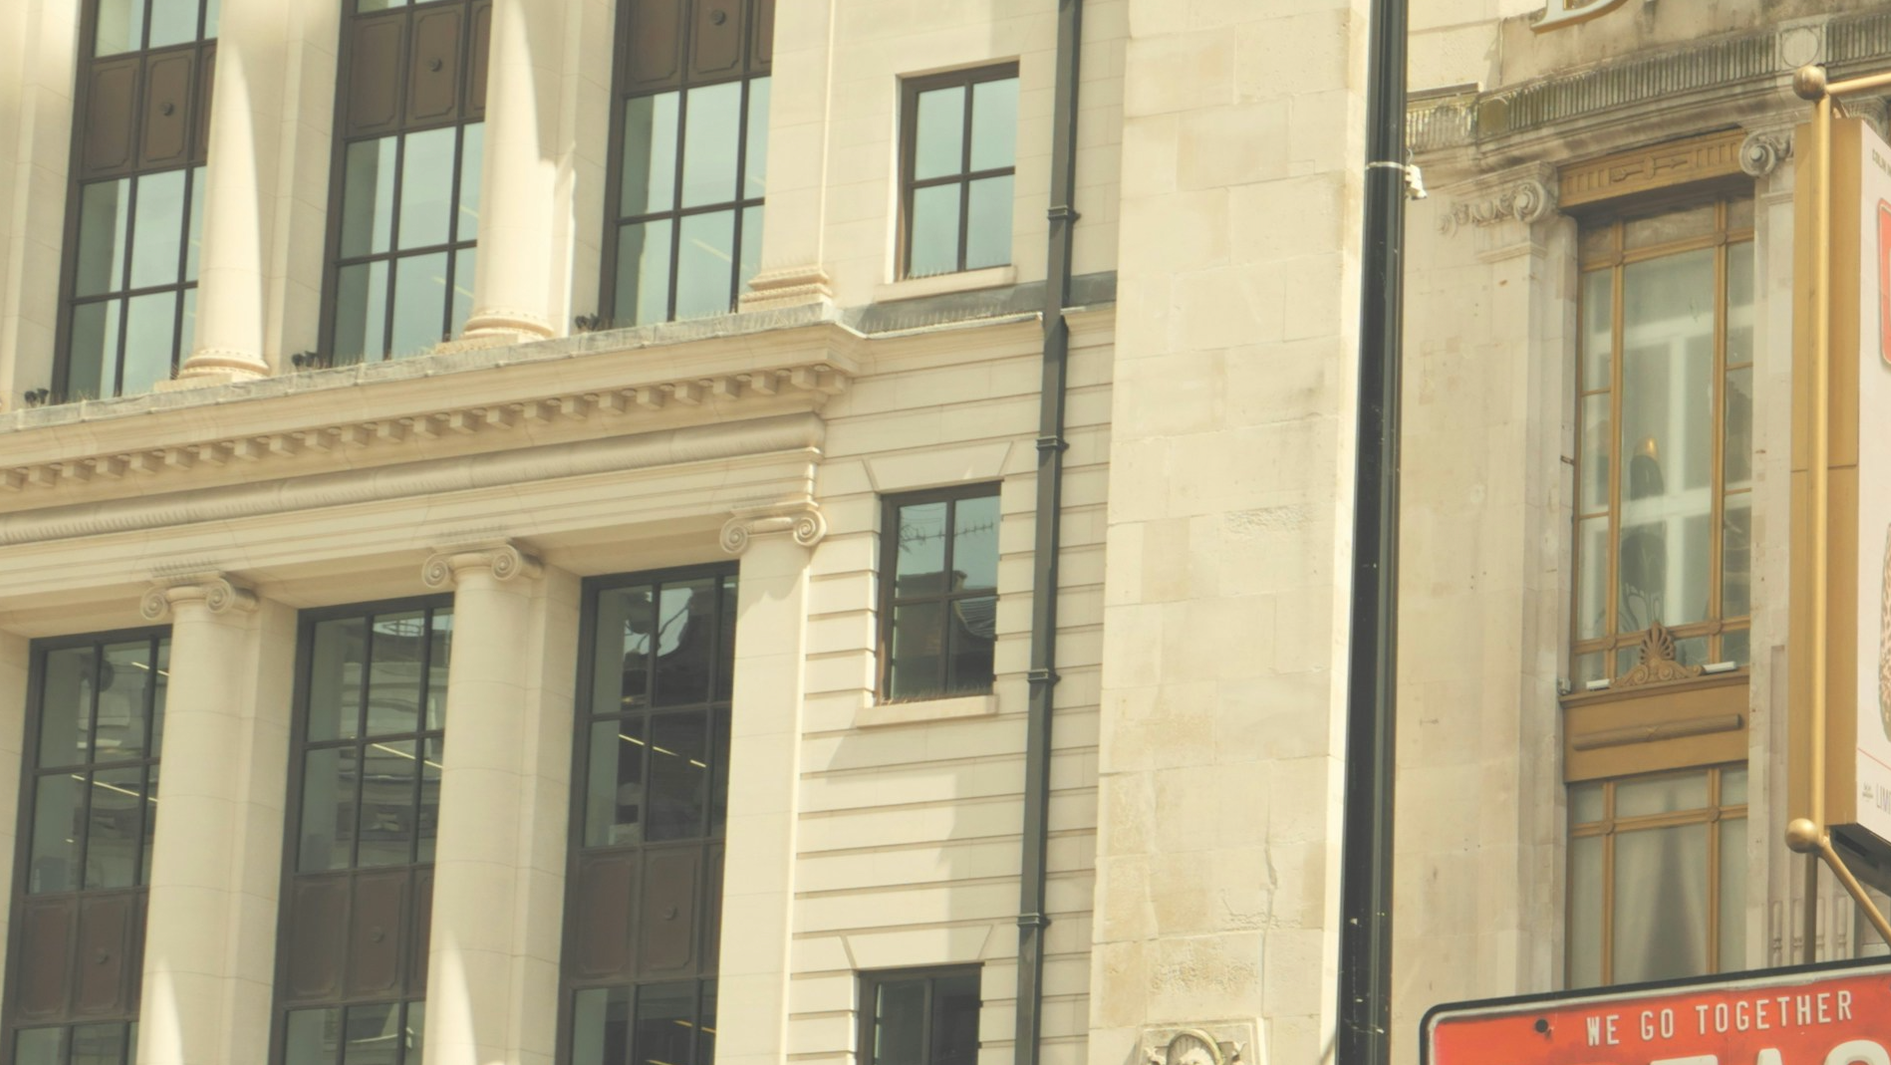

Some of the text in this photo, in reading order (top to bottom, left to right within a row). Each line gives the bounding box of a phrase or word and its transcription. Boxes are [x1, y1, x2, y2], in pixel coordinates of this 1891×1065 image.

[1586, 990, 1854, 1047] WE GO TOGETHER
